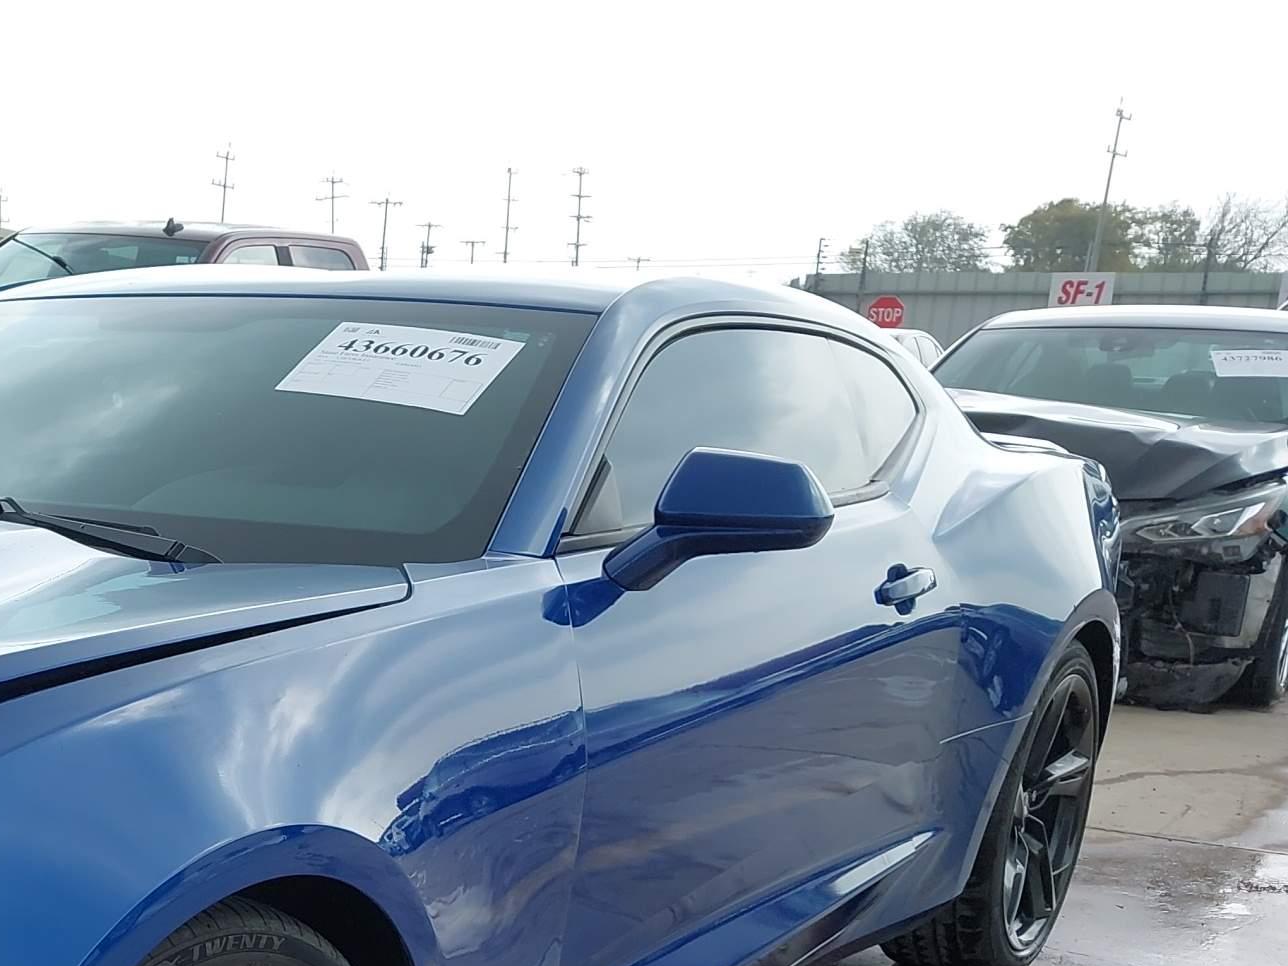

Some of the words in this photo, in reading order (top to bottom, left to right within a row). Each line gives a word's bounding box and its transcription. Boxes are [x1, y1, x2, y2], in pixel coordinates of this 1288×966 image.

[1057, 280, 1106, 304] SF-1
[868, 307, 902, 322] STOP
[337, 338, 488, 367] 43660676
